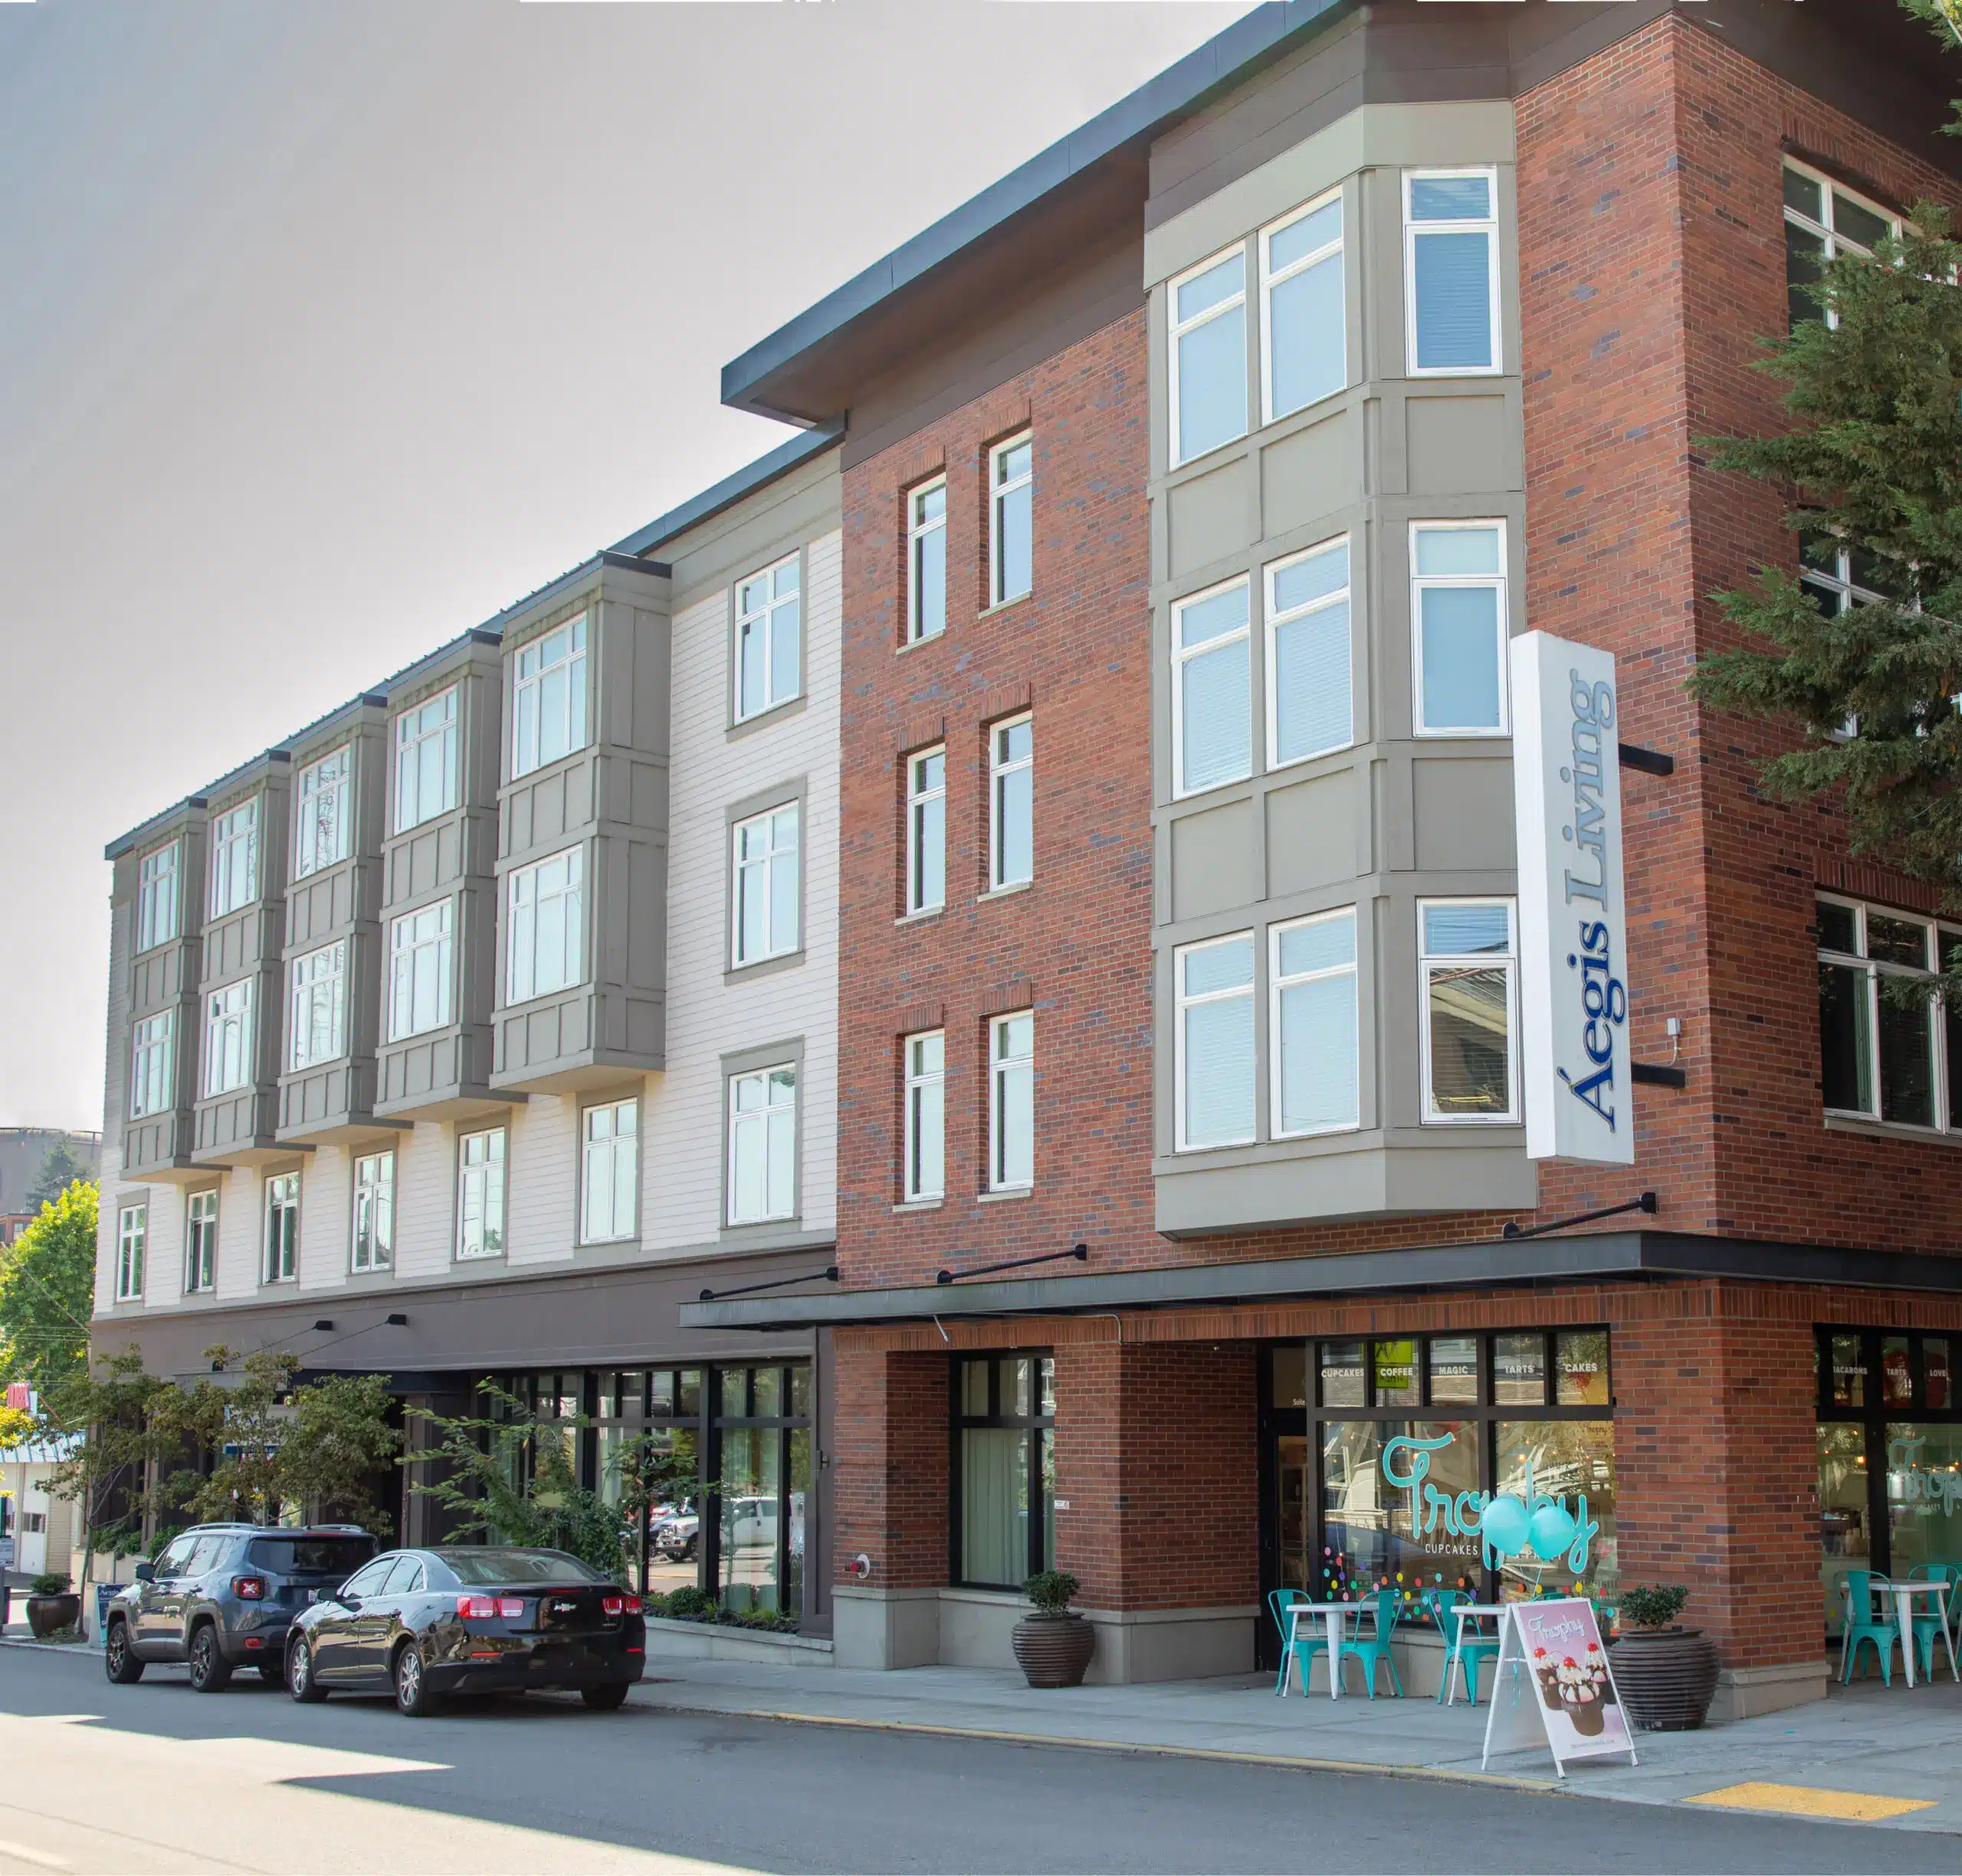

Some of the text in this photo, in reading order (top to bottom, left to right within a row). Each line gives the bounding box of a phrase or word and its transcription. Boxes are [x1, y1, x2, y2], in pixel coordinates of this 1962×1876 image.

[1560, 668, 1614, 912] Living
[1321, 1368, 1364, 1378] CUPCAKES
[1380, 1367, 1413, 1376] COFFEE
[1439, 1365, 1468, 1376] MAGIC
[1504, 1364, 1534, 1374] TARTS
[1565, 1363, 1598, 1373] CAKES
[1426, 1543, 1478, 1556] CUPCAKES
[1528, 1613, 1585, 1643] Trophy
